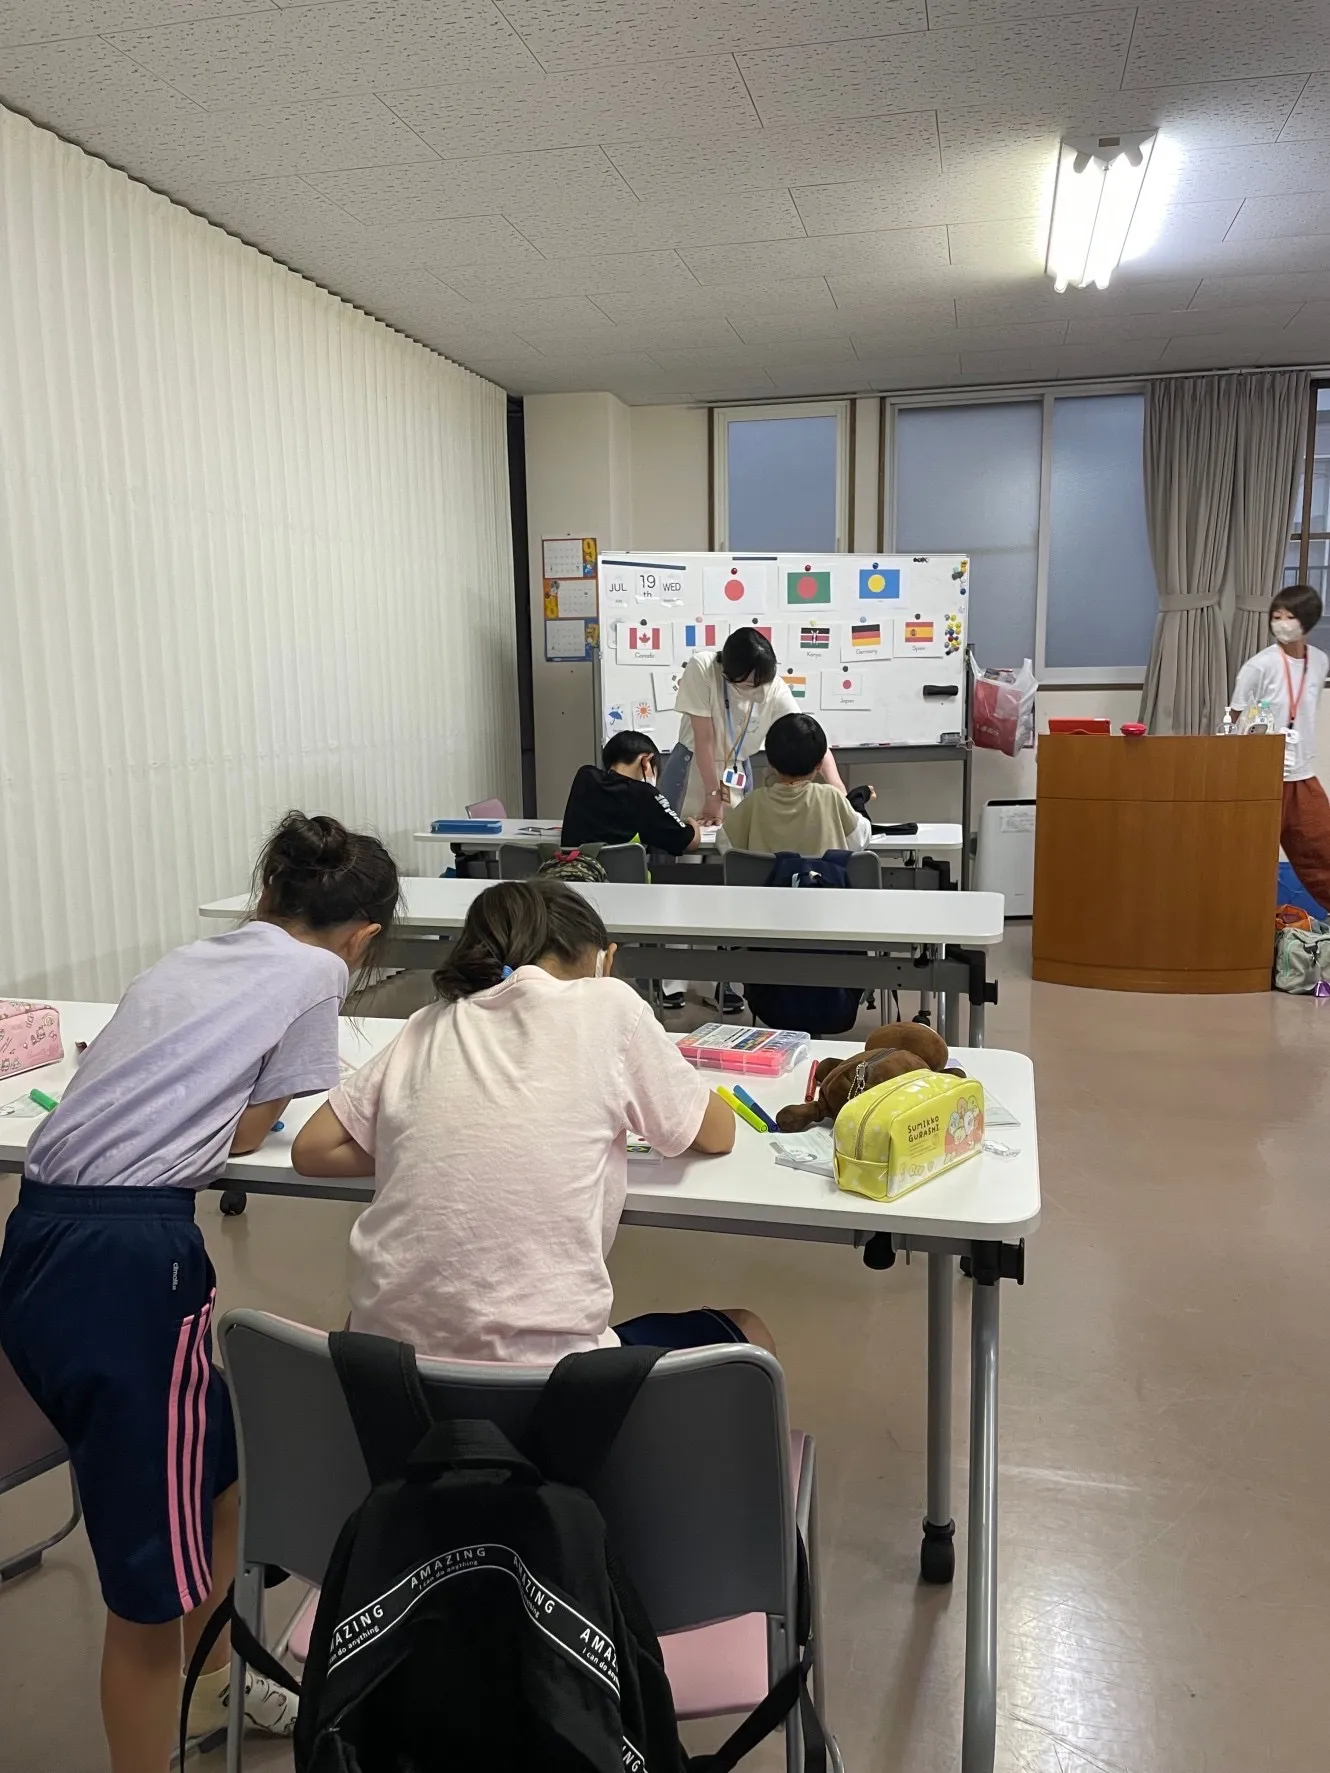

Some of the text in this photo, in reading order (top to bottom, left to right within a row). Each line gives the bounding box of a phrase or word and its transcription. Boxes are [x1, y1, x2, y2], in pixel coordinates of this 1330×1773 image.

[609, 574, 681, 592] JUL 19 WED
[411, 1548, 486, 1589] AMAZING
[447, 1560, 478, 1572] anything
[337, 1647, 347, 1656] do
[347, 1625, 380, 1648] anything
[586, 1652, 599, 1664] can
[599, 1661, 608, 1671] do
